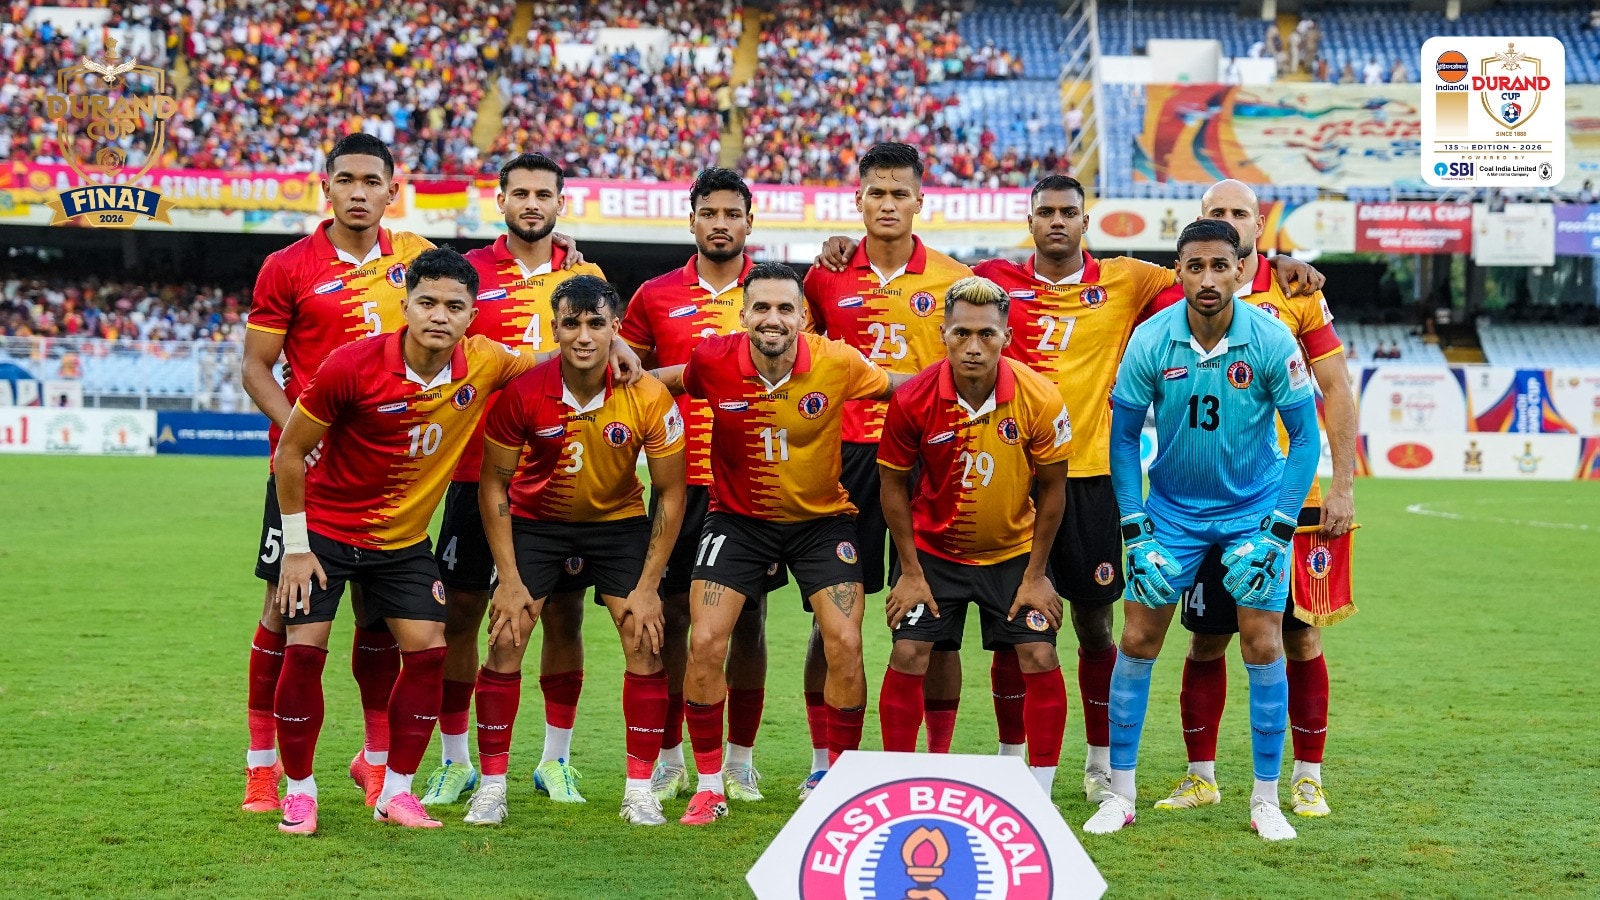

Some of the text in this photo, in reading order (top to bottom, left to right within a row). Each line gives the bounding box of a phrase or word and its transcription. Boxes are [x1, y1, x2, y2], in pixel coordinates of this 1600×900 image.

[160, 173, 223, 199] SINCE
[231, 178, 279, 200] 1920
[601, 188, 692, 218] BENG
[755, 191, 804, 212] THE
[815, 192, 861, 220] RE
[922, 193, 1031, 221] POWE
[1359, 205, 1406, 221] DESH
[1407, 205, 1433, 221] KA
[1434, 205, 1471, 221] CUP
[872, 288, 902, 296] emami
[362, 301, 382, 338] 5
[522, 313, 542, 350] 4
[1036, 316, 1078, 351] 27
[867, 322, 908, 360] 25
[1188, 395, 1220, 432] 13
[408, 423, 443, 457] 10
[564, 441, 584, 473] 3
[760, 427, 789, 461] 11
[959, 451, 995, 488] 29
[261, 527, 283, 564] 5
[442, 535, 458, 570] 4
[696, 533, 727, 567] 11
[703, 591, 722, 606] NOT
[811, 786, 1043, 887] EAST BENGAL
